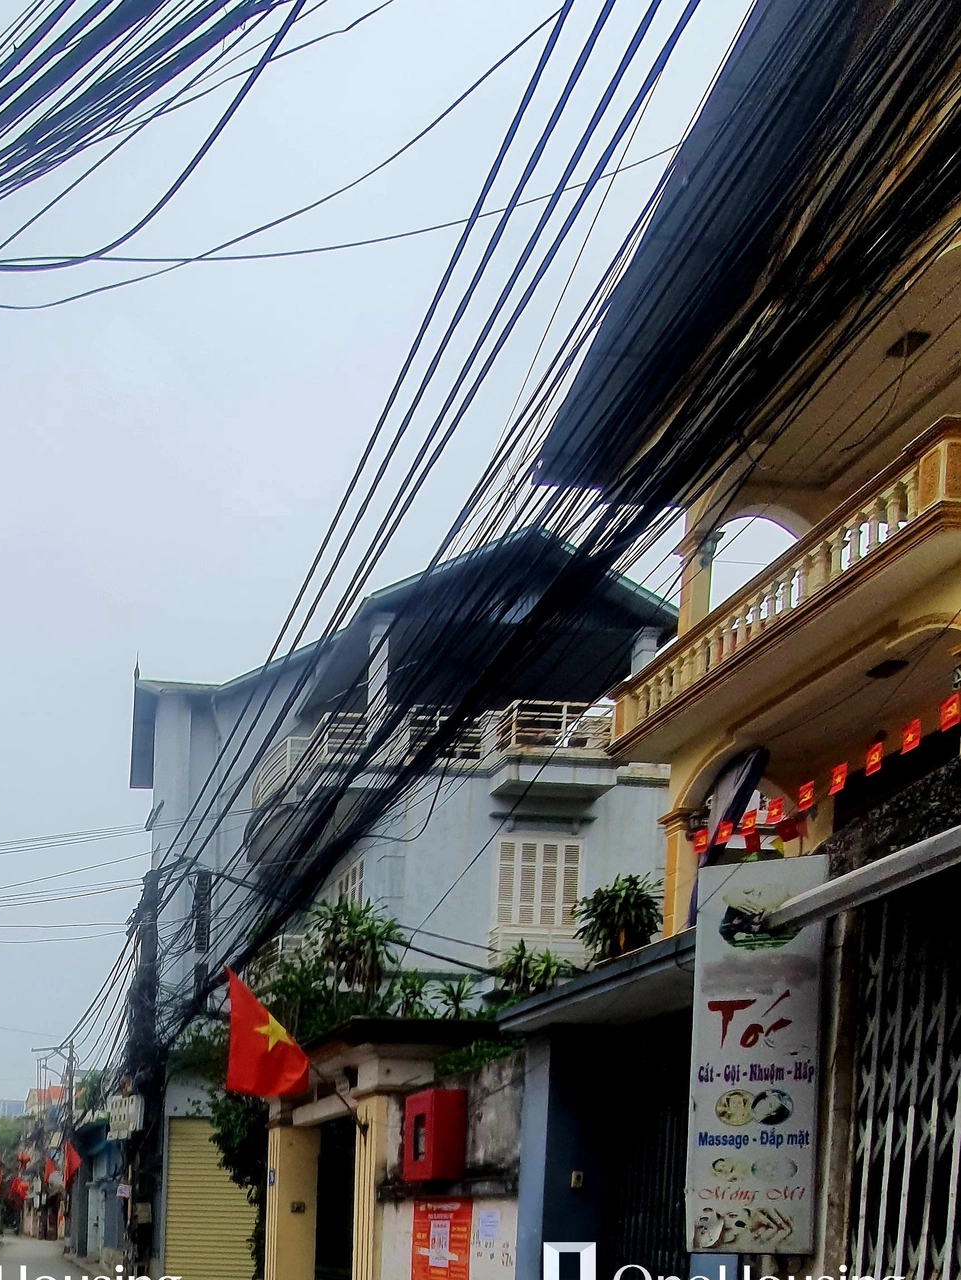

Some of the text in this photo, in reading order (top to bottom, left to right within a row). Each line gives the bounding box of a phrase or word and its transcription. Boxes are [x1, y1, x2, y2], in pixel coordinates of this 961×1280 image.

[698, 1131, 750, 1150] Massage
[760, 1128, 784, 1149] Đắp
[786, 1130, 810, 1148] mặt
